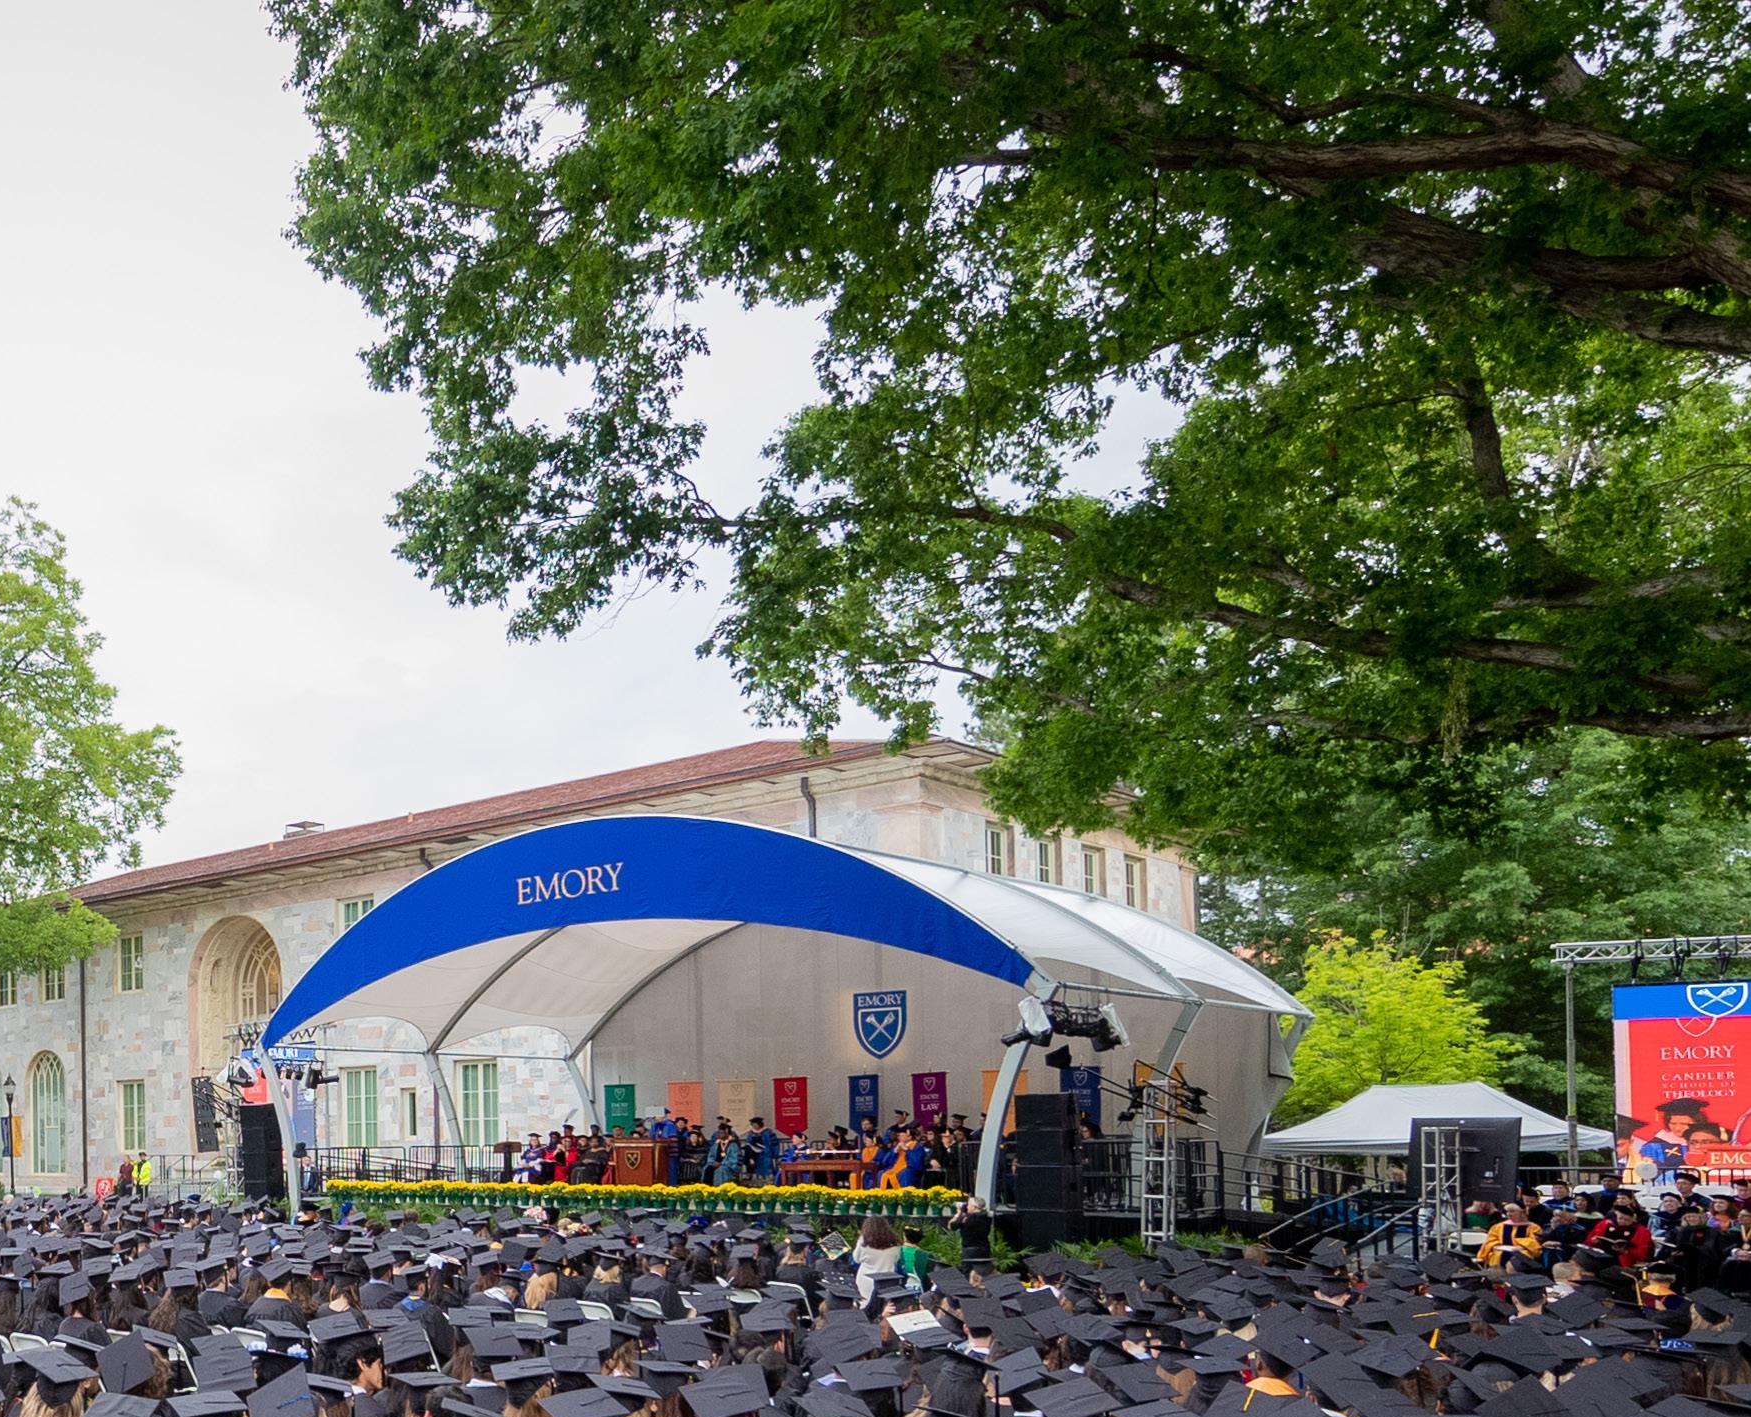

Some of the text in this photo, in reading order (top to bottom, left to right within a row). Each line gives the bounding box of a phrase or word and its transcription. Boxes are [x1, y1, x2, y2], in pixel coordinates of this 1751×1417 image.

[516, 862, 624, 905] EMORY
[857, 993, 903, 1008] EMORY
[1660, 1045, 1734, 1060] EMORY
[1661, 1071, 1736, 1081] CANDLER
[1662, 1089, 1736, 1099] THEOLOGY
[921, 1103, 940, 1111] LAW
